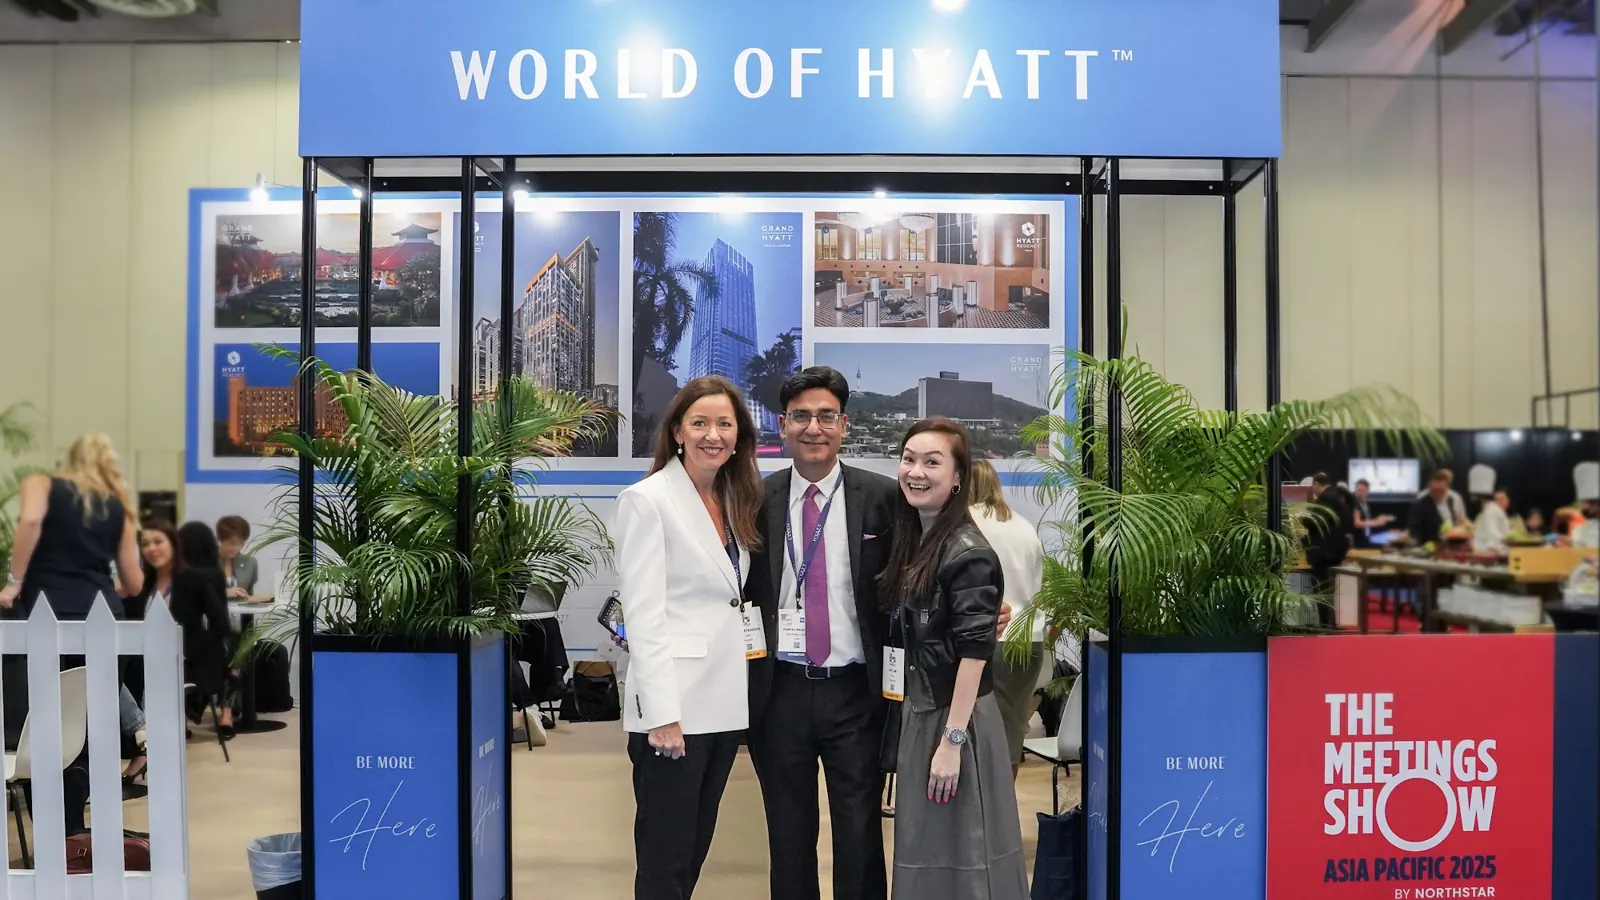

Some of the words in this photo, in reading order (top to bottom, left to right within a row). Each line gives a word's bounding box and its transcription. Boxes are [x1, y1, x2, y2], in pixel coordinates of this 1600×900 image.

[450, 48, 698, 100] WORLD
[733, 48, 823, 99] OF
[858, 48, 1099, 100] HYATT
[1325, 692, 1394, 736] THE
[356, 755, 373, 769] BE
[377, 756, 416, 769] MORE
[1166, 756, 1184, 770] BE
[1187, 756, 1227, 770] MORE
[1324, 739, 1498, 785] MEETINGS
[329, 779, 437, 871] Here
[1136, 780, 1246, 874] Here
[1324, 768, 1497, 852] SHOW
[1323, 858, 1370, 883] ASIA
[1374, 856, 1446, 881] PACIFIC
[1449, 855, 1497, 880] 2025
[1394, 888, 1411, 900] BY
[1415, 886, 1496, 899] NORTHSTAR
